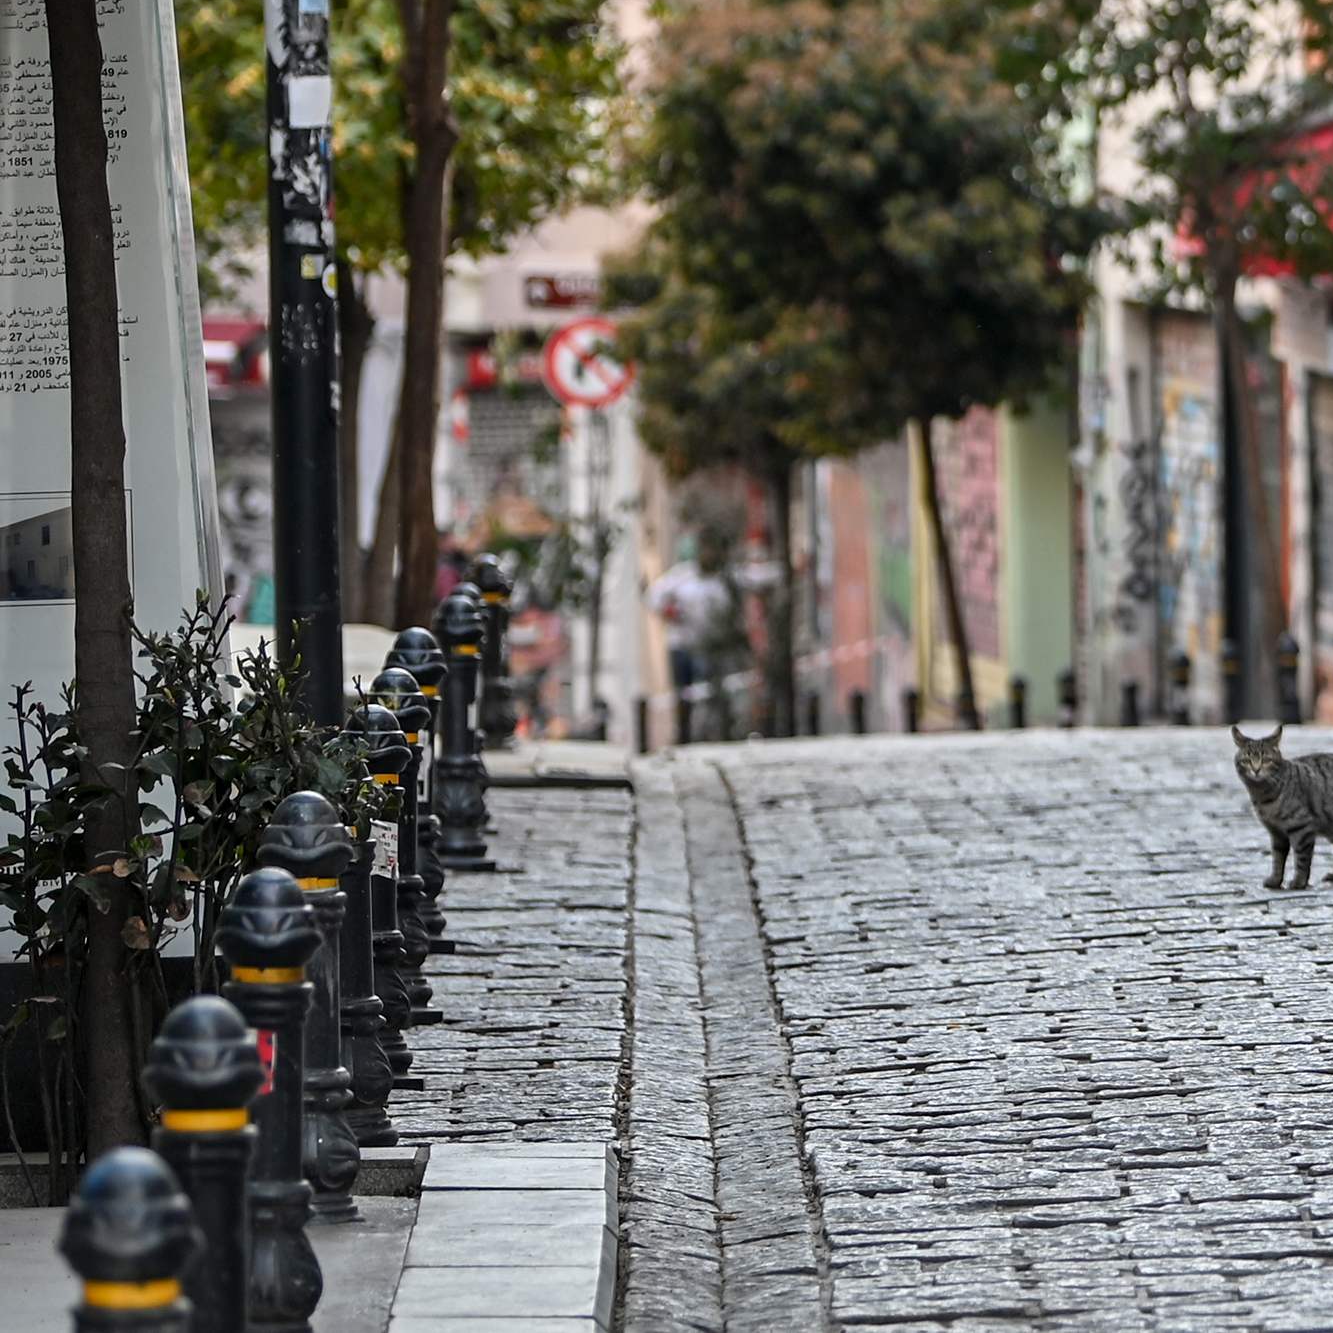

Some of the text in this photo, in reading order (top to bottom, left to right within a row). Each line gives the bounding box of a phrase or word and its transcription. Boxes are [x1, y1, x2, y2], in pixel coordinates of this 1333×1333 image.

[107, 129, 128, 138] 819
[8, 157, 33, 166] 1851
[9, 332, 23, 342] 27
[25, 369, 52, 379] 2005
[14, 382, 26, 392] 21
